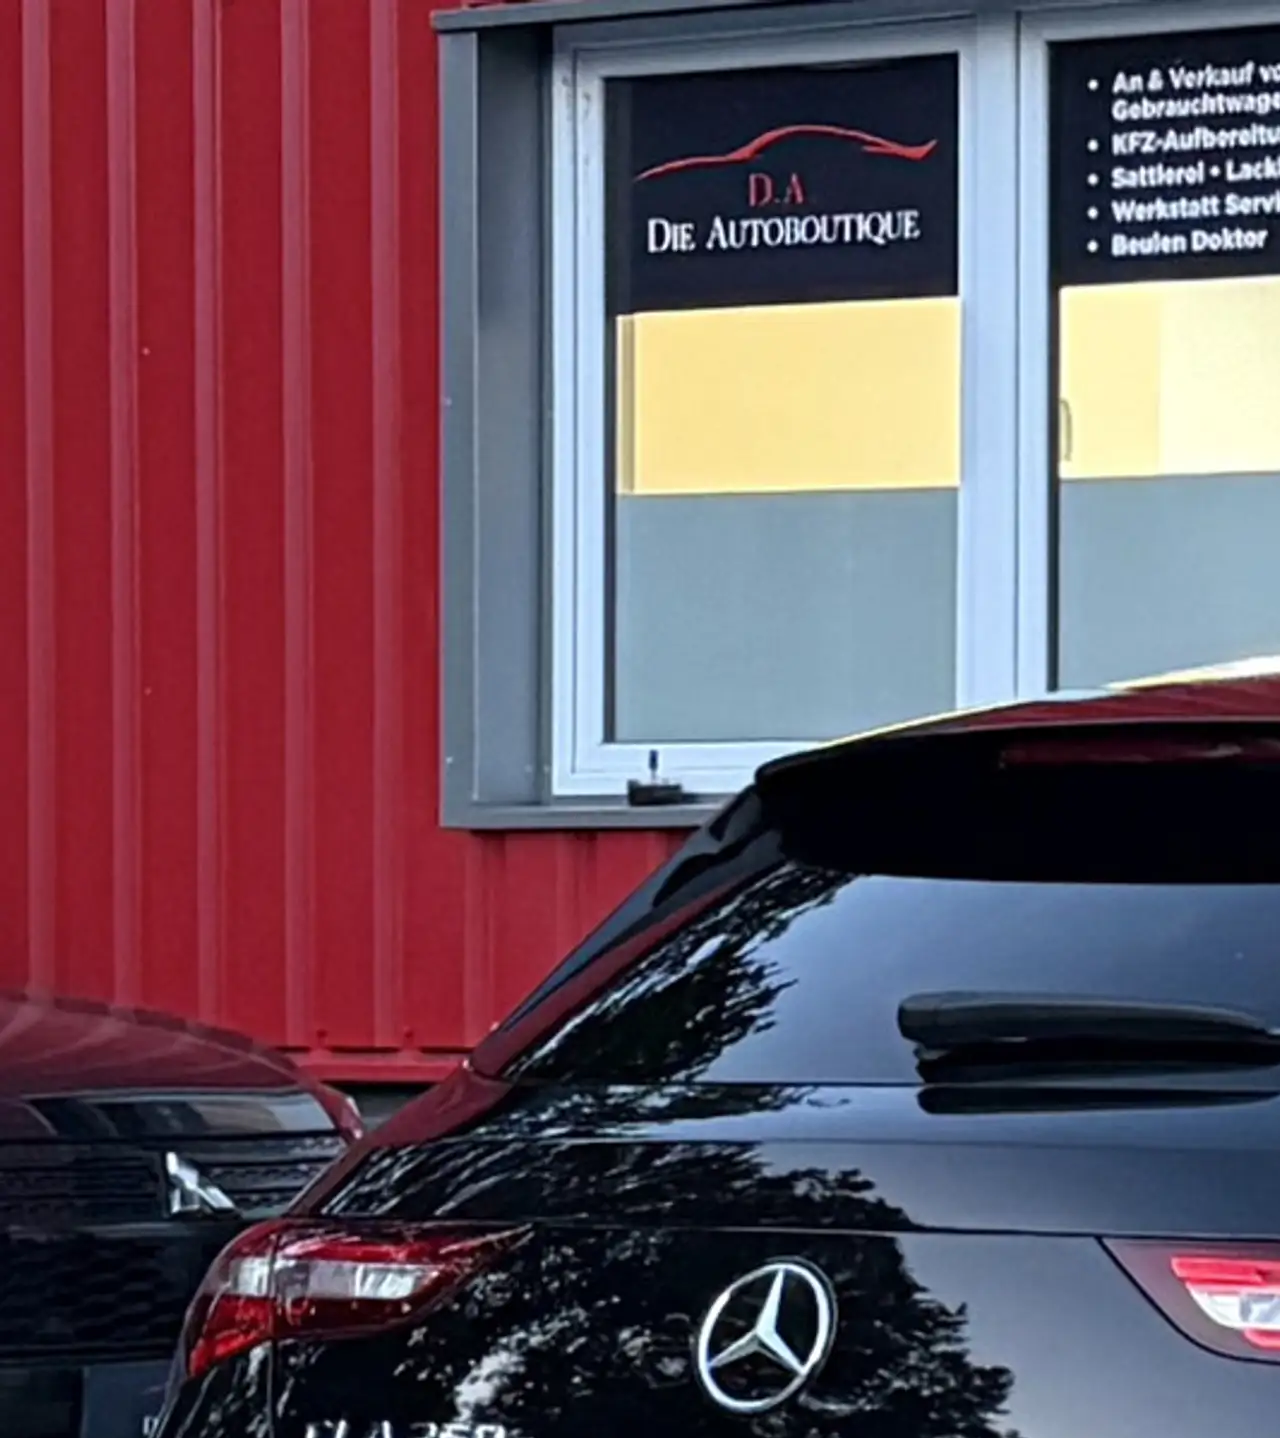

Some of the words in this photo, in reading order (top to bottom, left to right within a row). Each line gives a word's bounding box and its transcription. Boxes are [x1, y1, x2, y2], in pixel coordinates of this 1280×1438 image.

[1112, 71, 1143, 94] An
[1148, 68, 1163, 91] &
[1169, 60, 1255, 90] Verkauf
[1111, 160, 1205, 189] Sattlerei
[1111, 195, 1220, 223] Werkstatt
[1111, 230, 1188, 257] Beulen
[1191, 227, 1268, 252] Doktor
